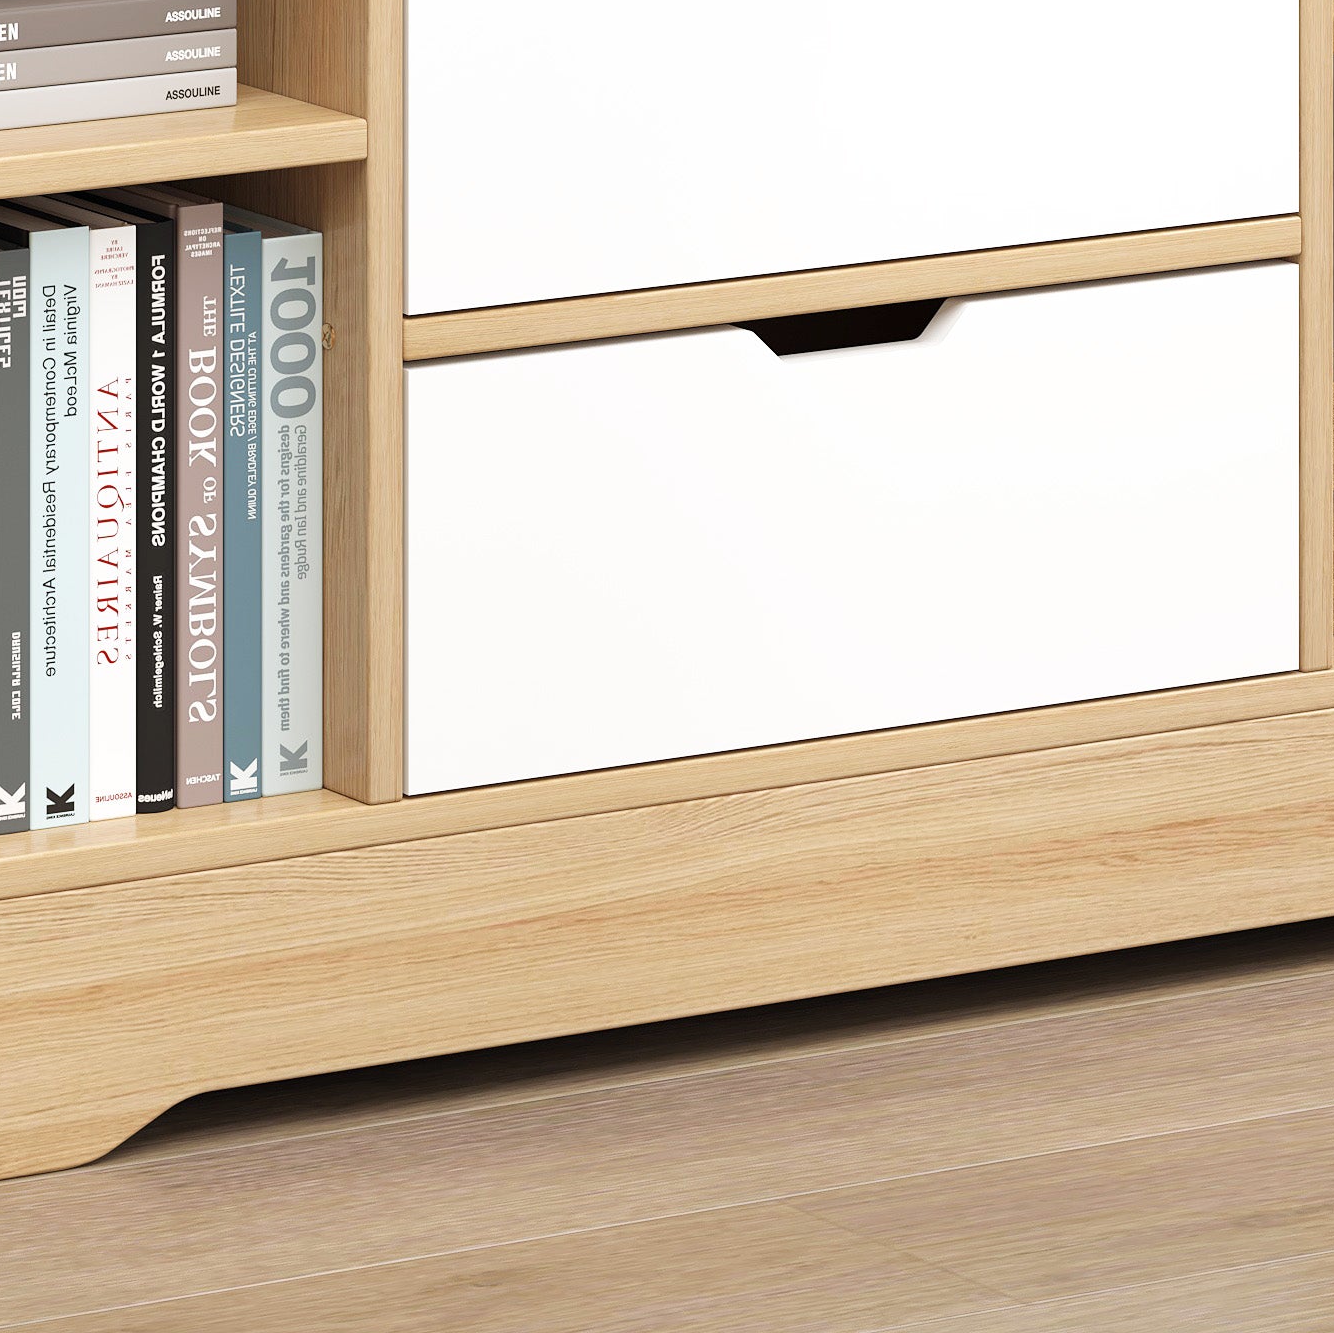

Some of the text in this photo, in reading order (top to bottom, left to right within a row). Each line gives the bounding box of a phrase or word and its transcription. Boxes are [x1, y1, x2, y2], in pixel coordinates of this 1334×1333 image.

[165, 7, 221, 23] ASSOULINE
[165, 46, 221, 61] ASSOULINE
[165, 85, 221, 100] ASSOULINE
